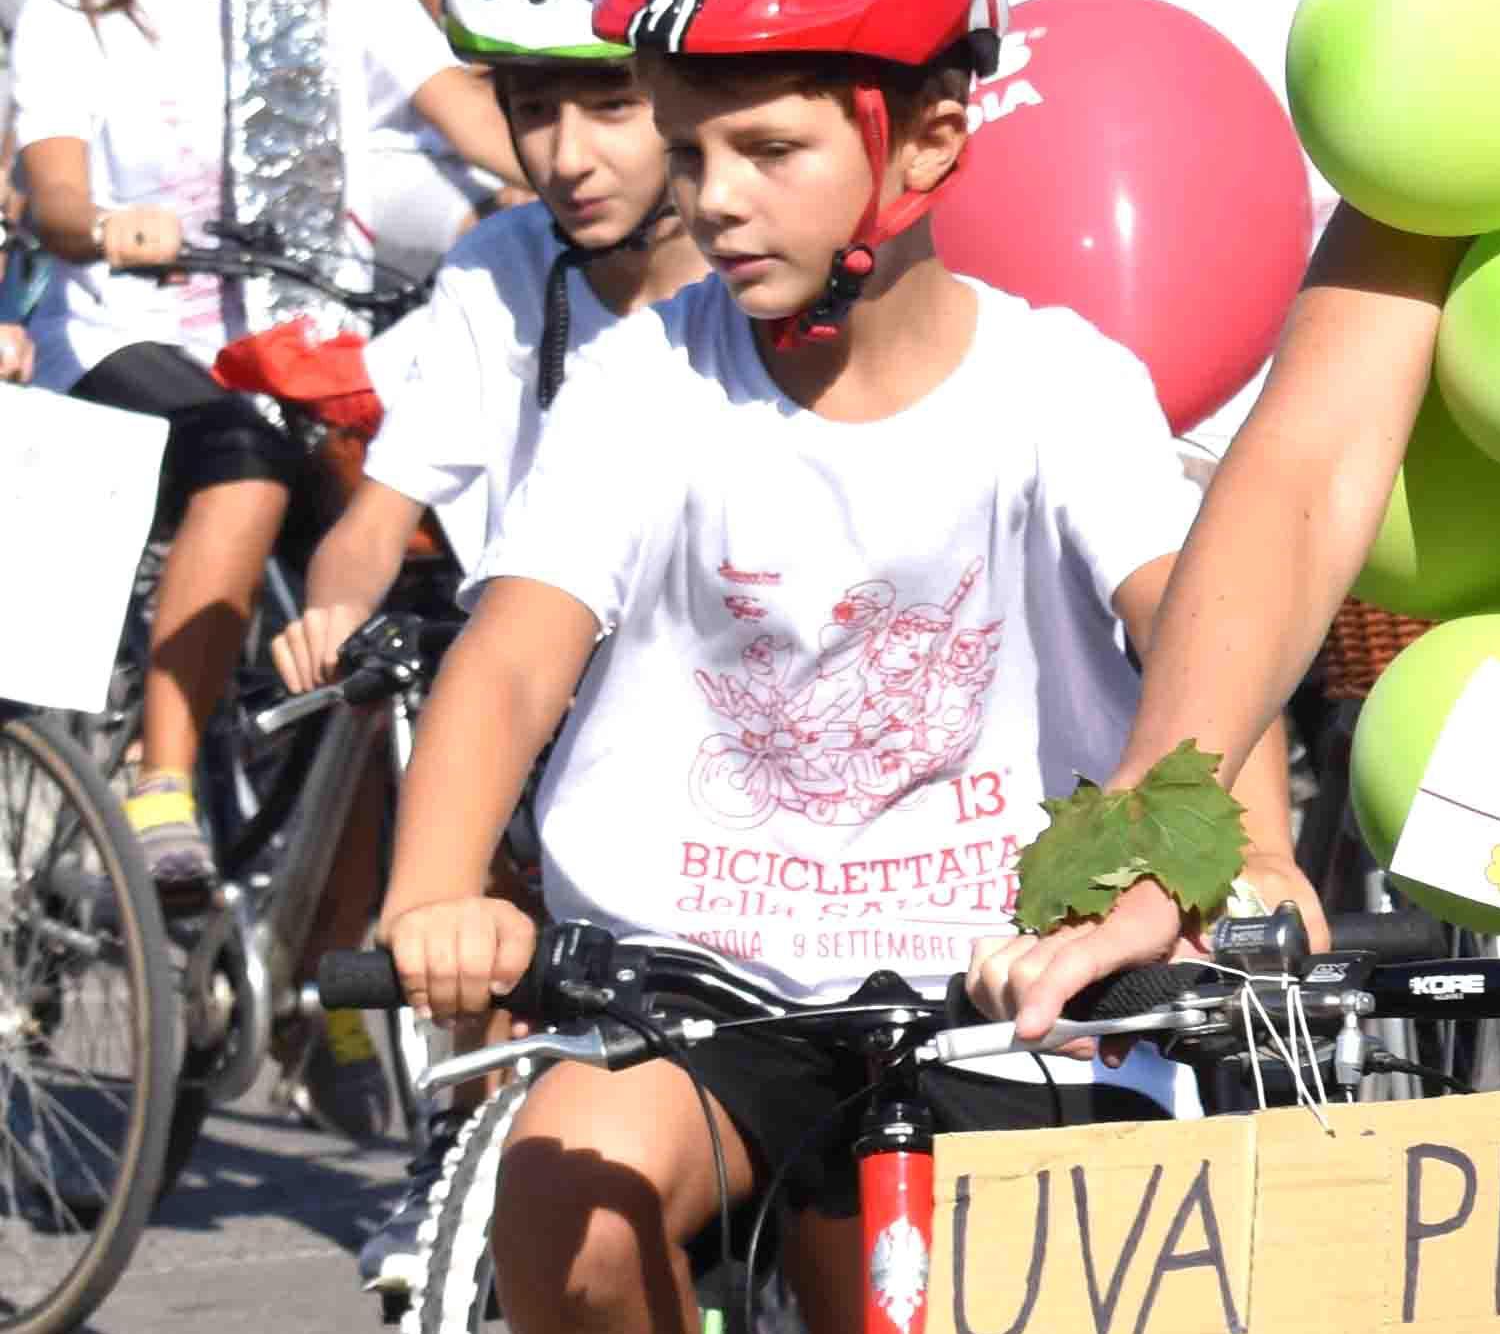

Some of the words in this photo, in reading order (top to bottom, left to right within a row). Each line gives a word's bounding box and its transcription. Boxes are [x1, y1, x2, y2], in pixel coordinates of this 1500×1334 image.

[680, 835, 1024, 895] BICICLETTATA
[793, 932, 806, 958] 9
[1410, 974, 1486, 994] KORE
